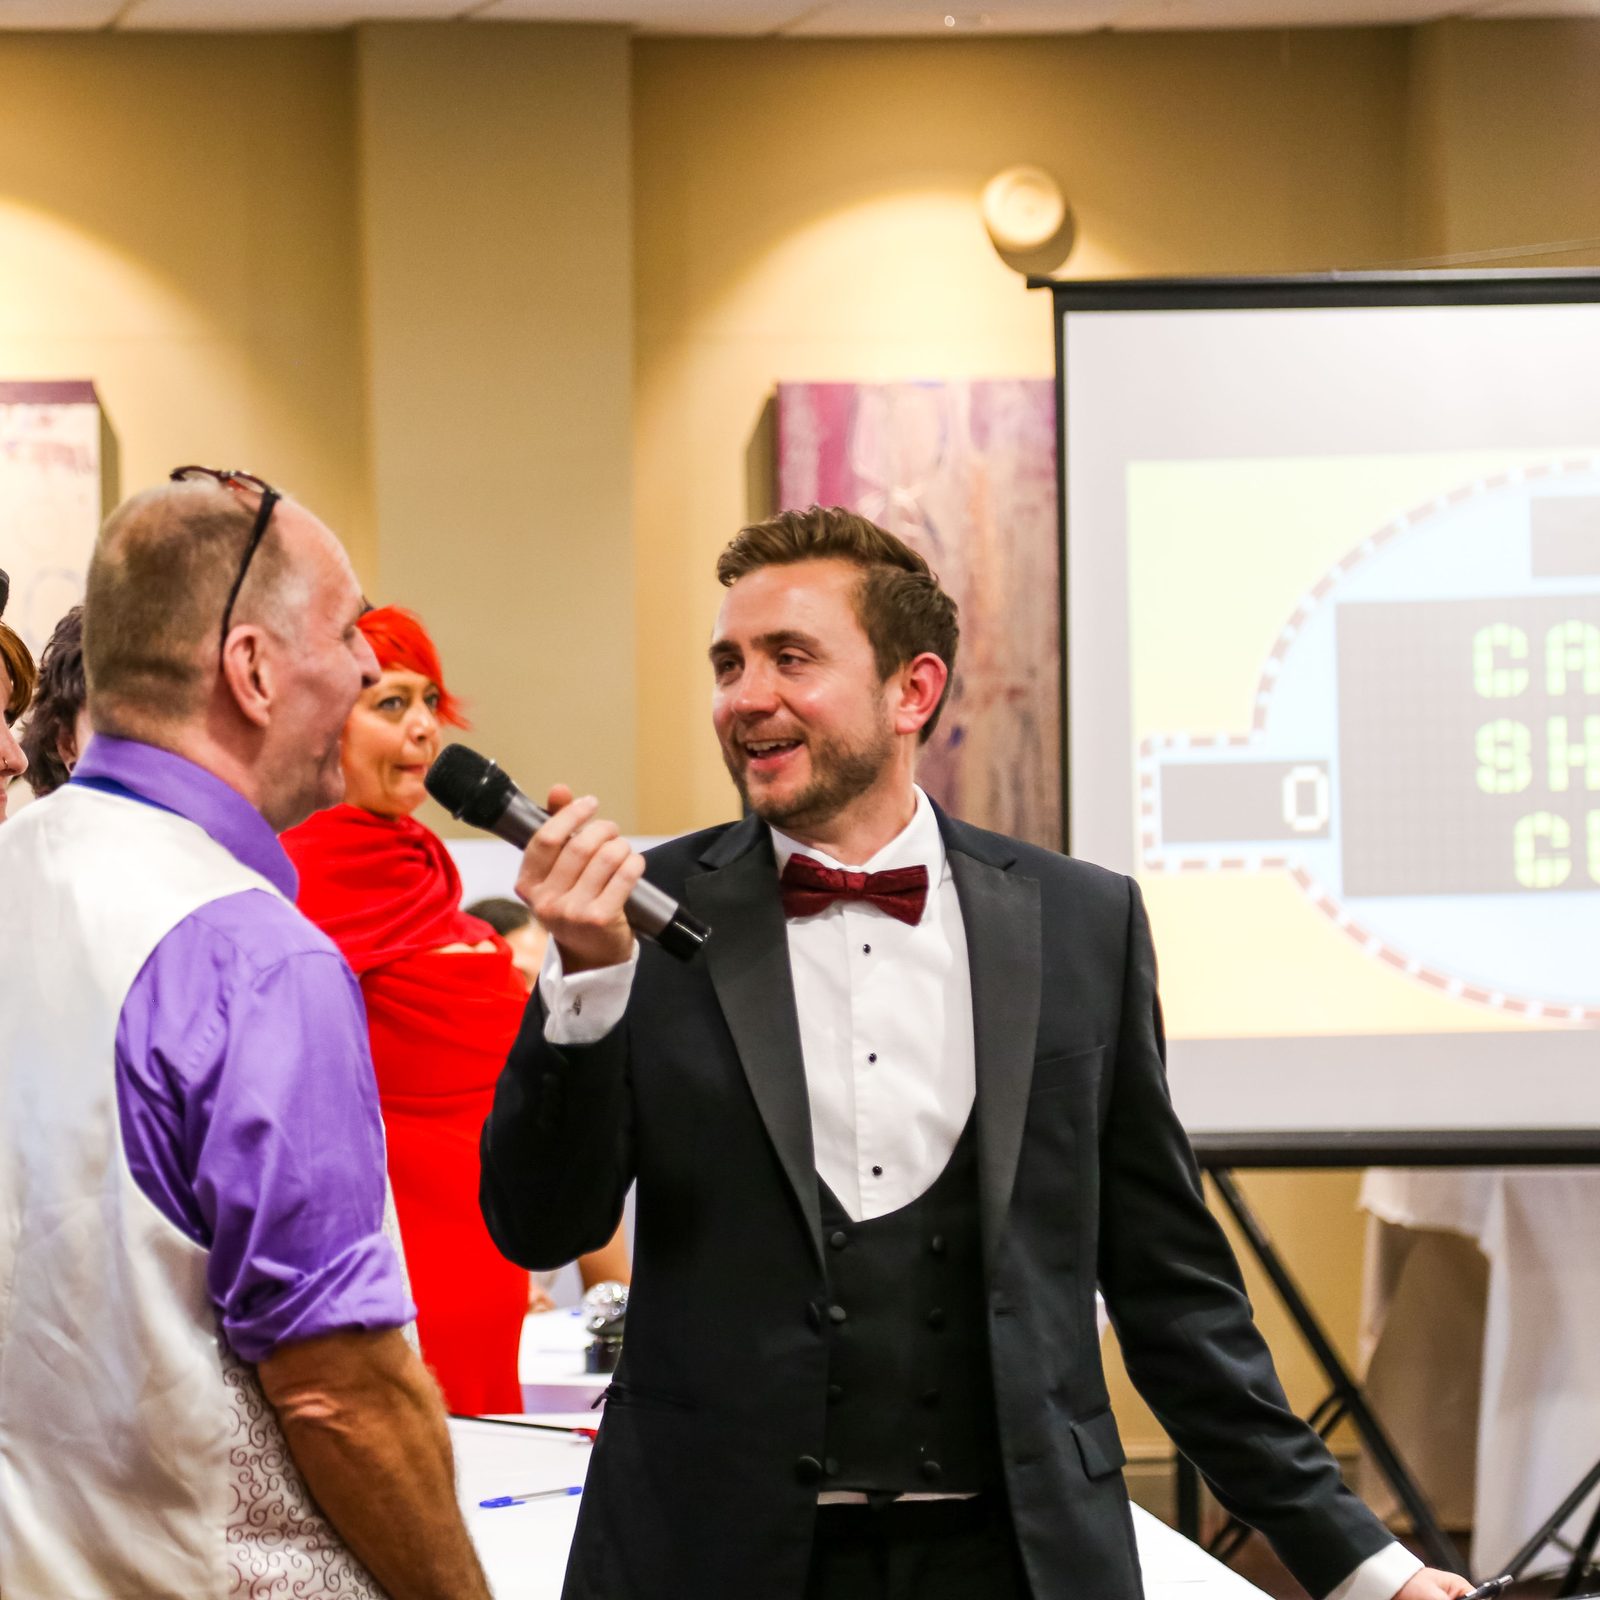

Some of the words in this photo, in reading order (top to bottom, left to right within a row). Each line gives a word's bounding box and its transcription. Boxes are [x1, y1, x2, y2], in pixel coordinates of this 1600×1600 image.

[1473, 619, 1600, 698] CA
[1475, 714, 1600, 794] SH
[1513, 809, 1600, 889] C
